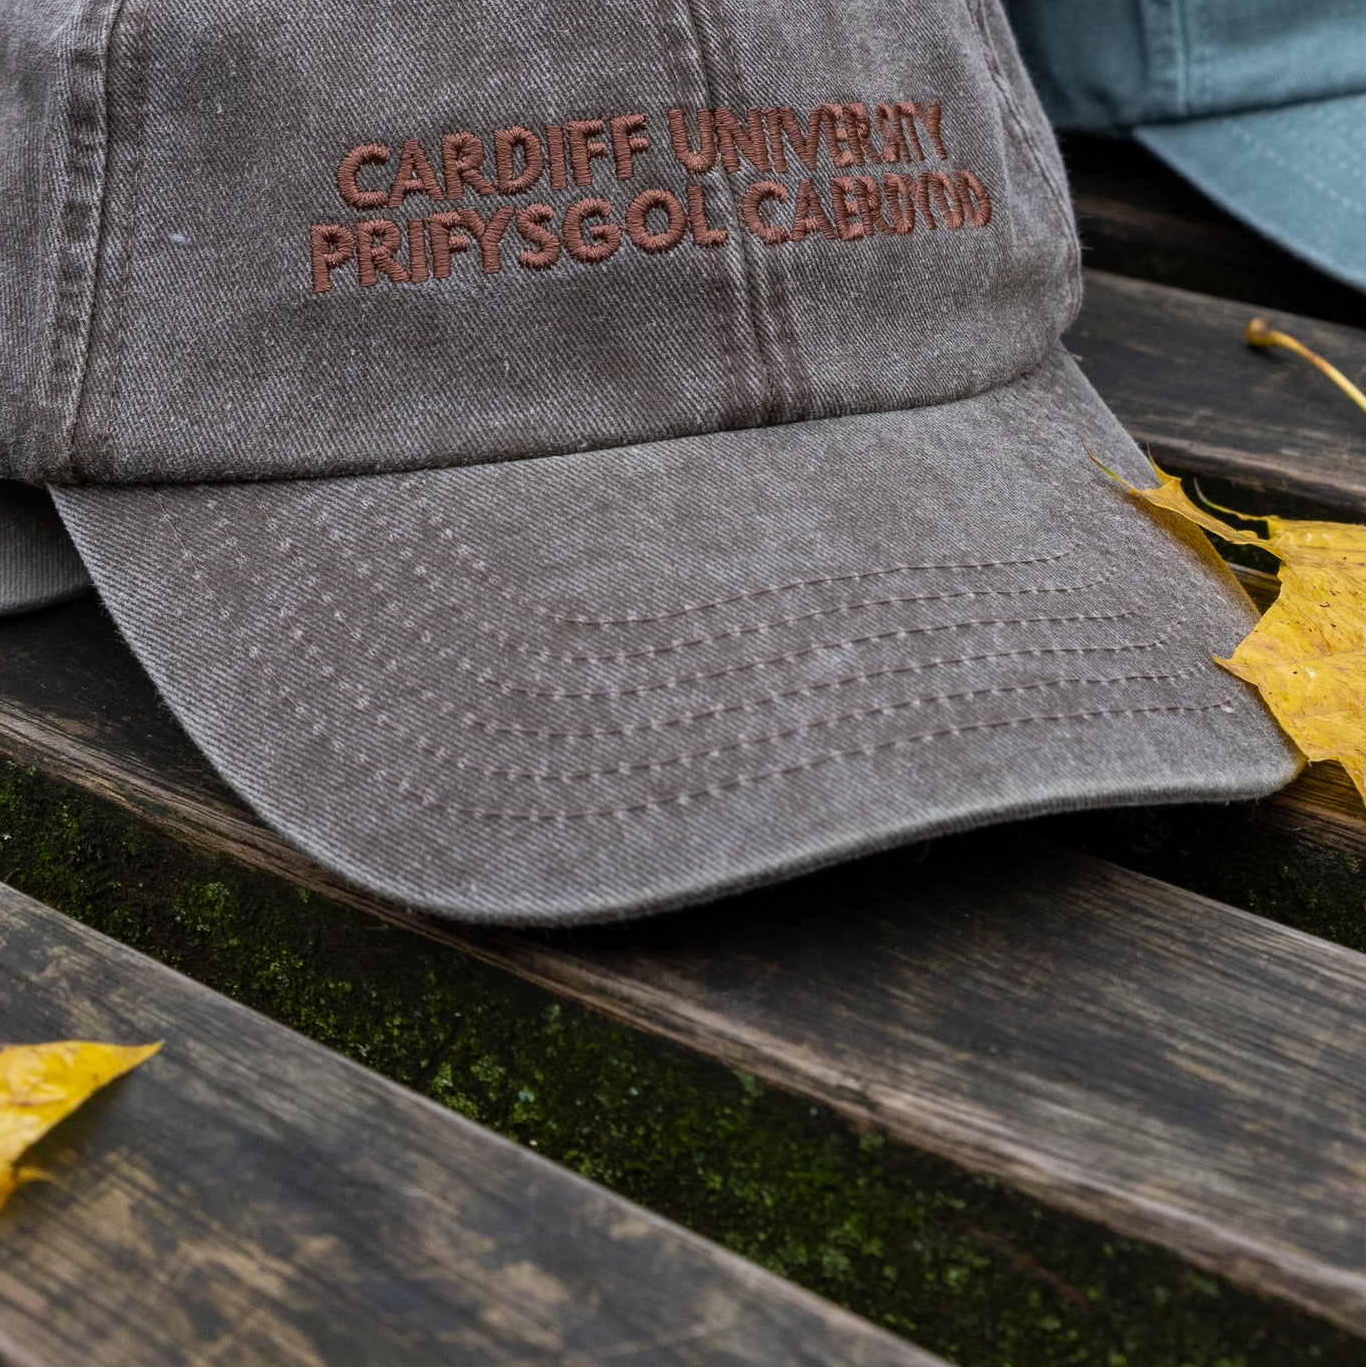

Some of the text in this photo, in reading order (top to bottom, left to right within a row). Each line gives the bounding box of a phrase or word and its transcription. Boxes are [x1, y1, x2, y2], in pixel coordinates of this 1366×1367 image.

[337, 100, 948, 210] CARDIFF UNIVERSITY
[310, 170, 992, 294] PRIFYSGOL CAERDYDD
